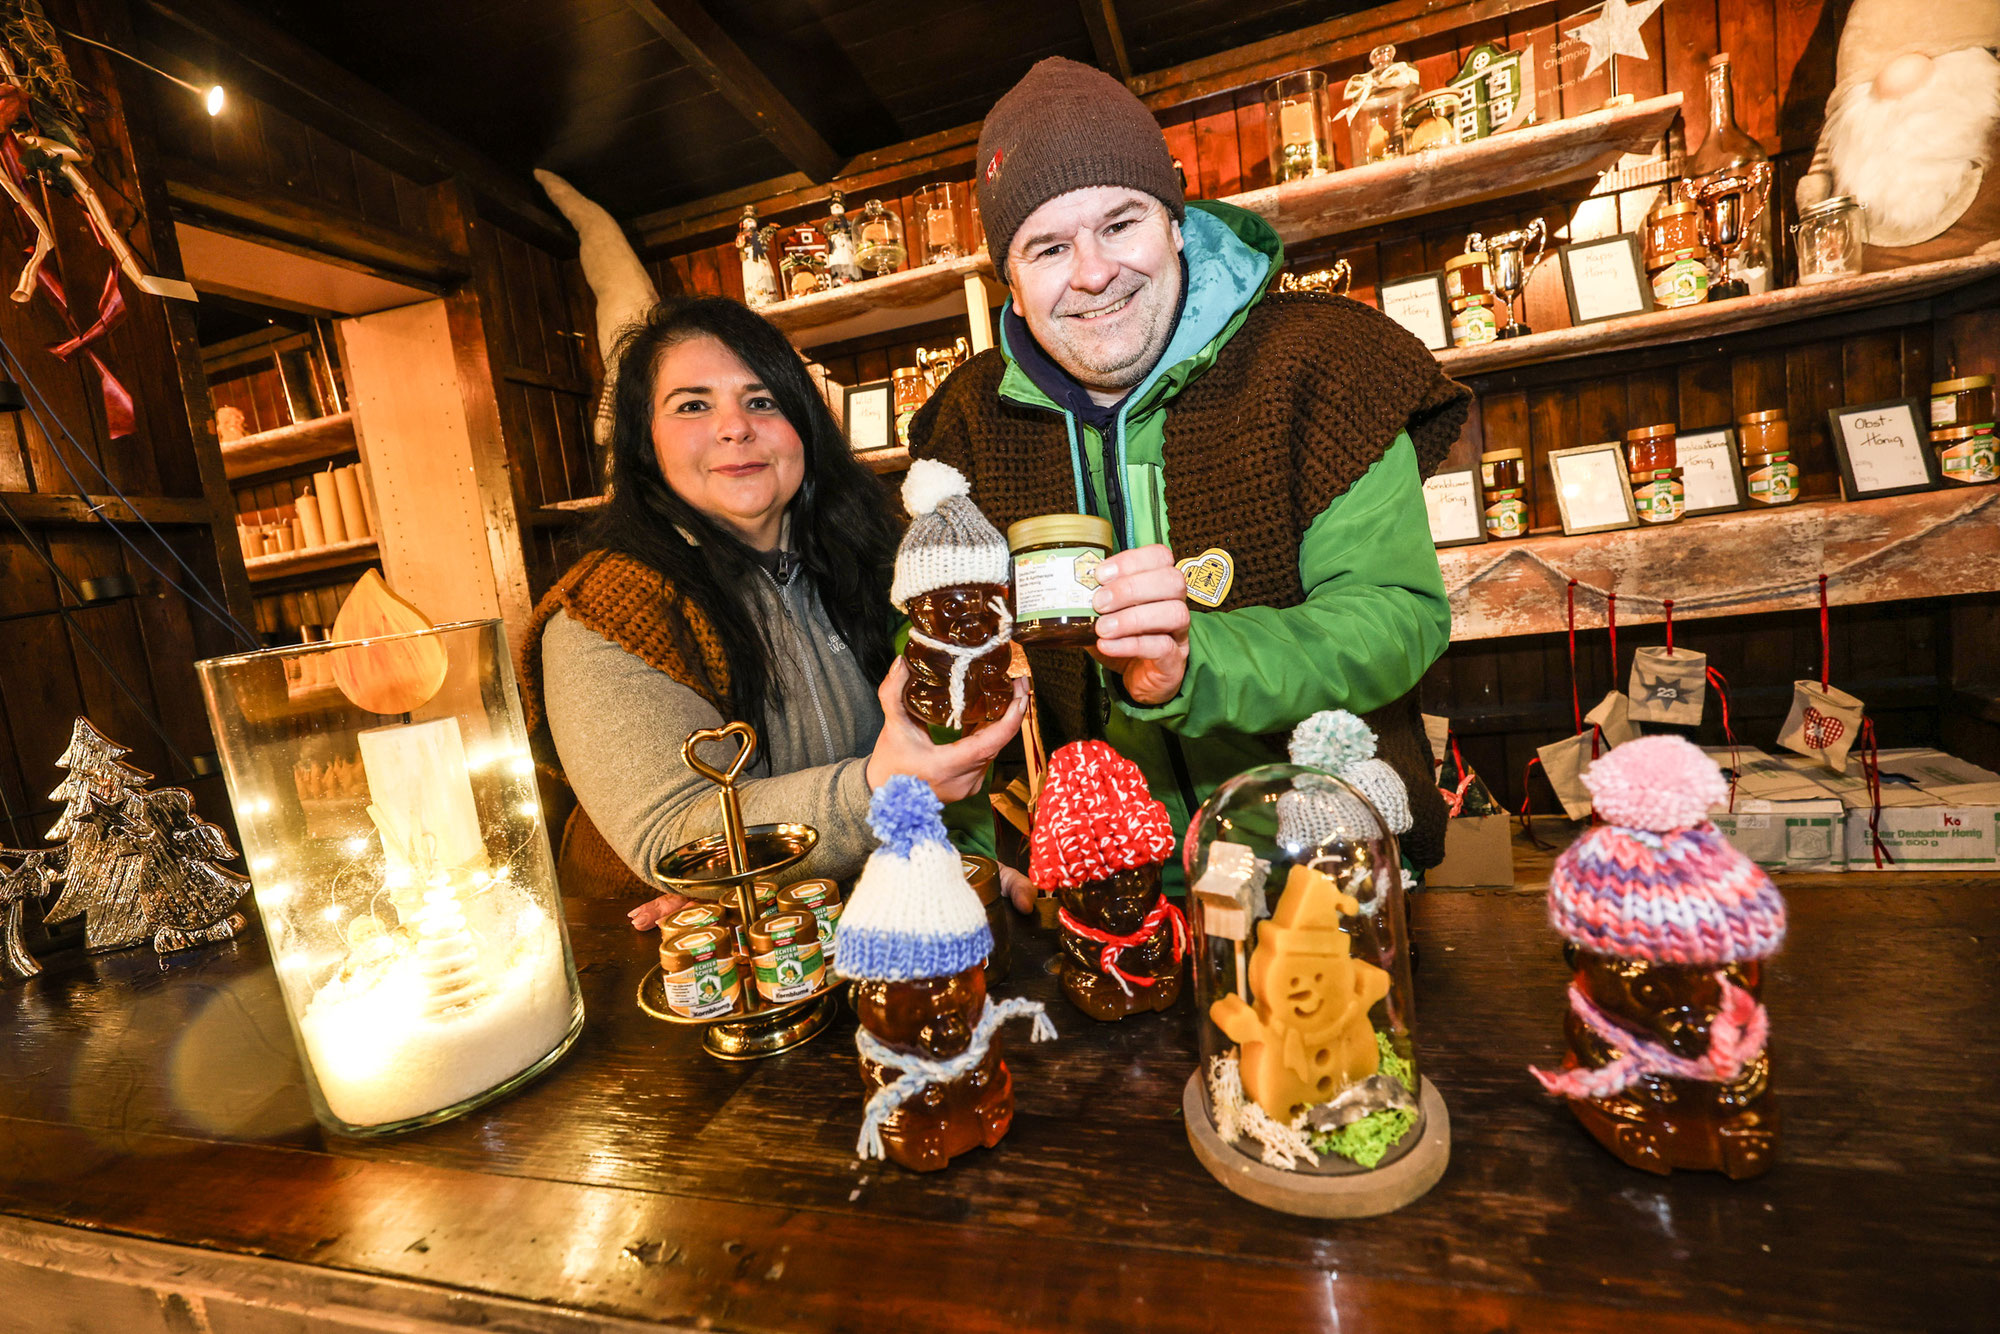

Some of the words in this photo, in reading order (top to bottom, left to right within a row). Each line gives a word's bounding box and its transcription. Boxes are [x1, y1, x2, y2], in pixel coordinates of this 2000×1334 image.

[1549, 36, 1582, 54] Servic
[1543, 47, 1590, 70] Champio
[1854, 415, 1893, 430] Obst-
[1860, 432, 1904, 448] Honig
[1440, 493, 1467, 507] Honig
[1656, 687, 1677, 698] 23
[1897, 829, 1949, 839] Deutscher
[1951, 828, 1982, 839] Honig
[774, 945, 798, 957] ECHTER
[694, 959, 718, 972] ECHTER
